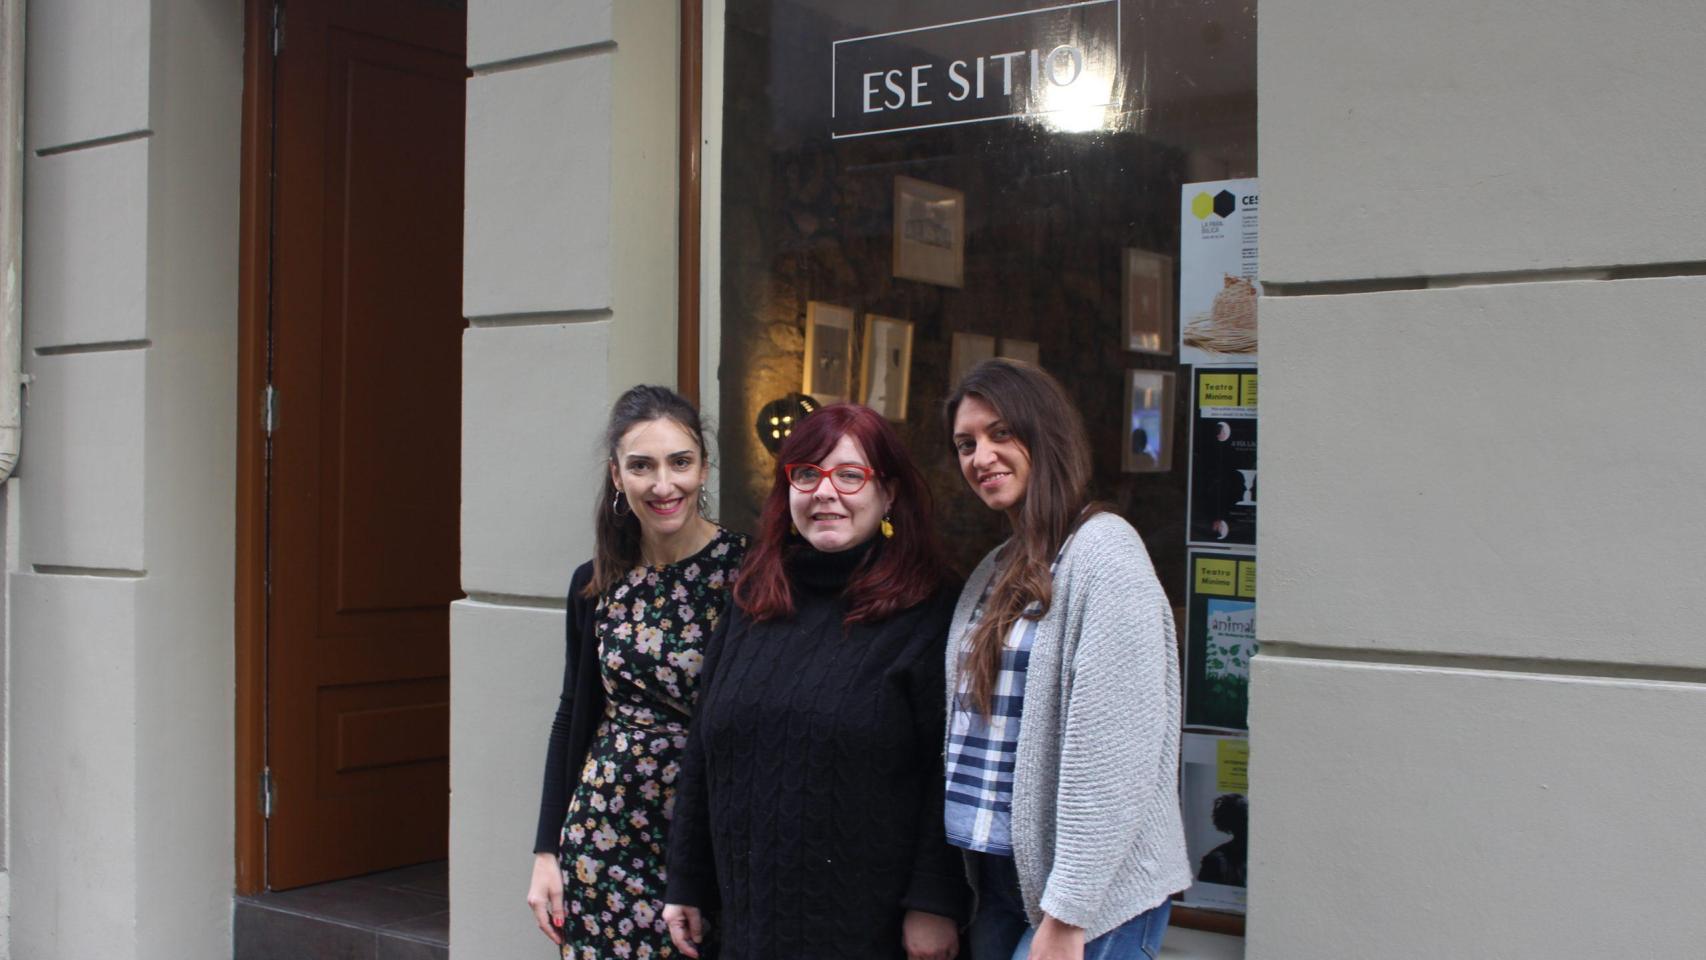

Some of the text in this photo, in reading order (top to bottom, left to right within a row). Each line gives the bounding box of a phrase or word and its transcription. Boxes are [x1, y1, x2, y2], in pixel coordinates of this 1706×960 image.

[863, 44, 1083, 113] ESE SITIO
[1204, 383, 1233, 391] Teatro
